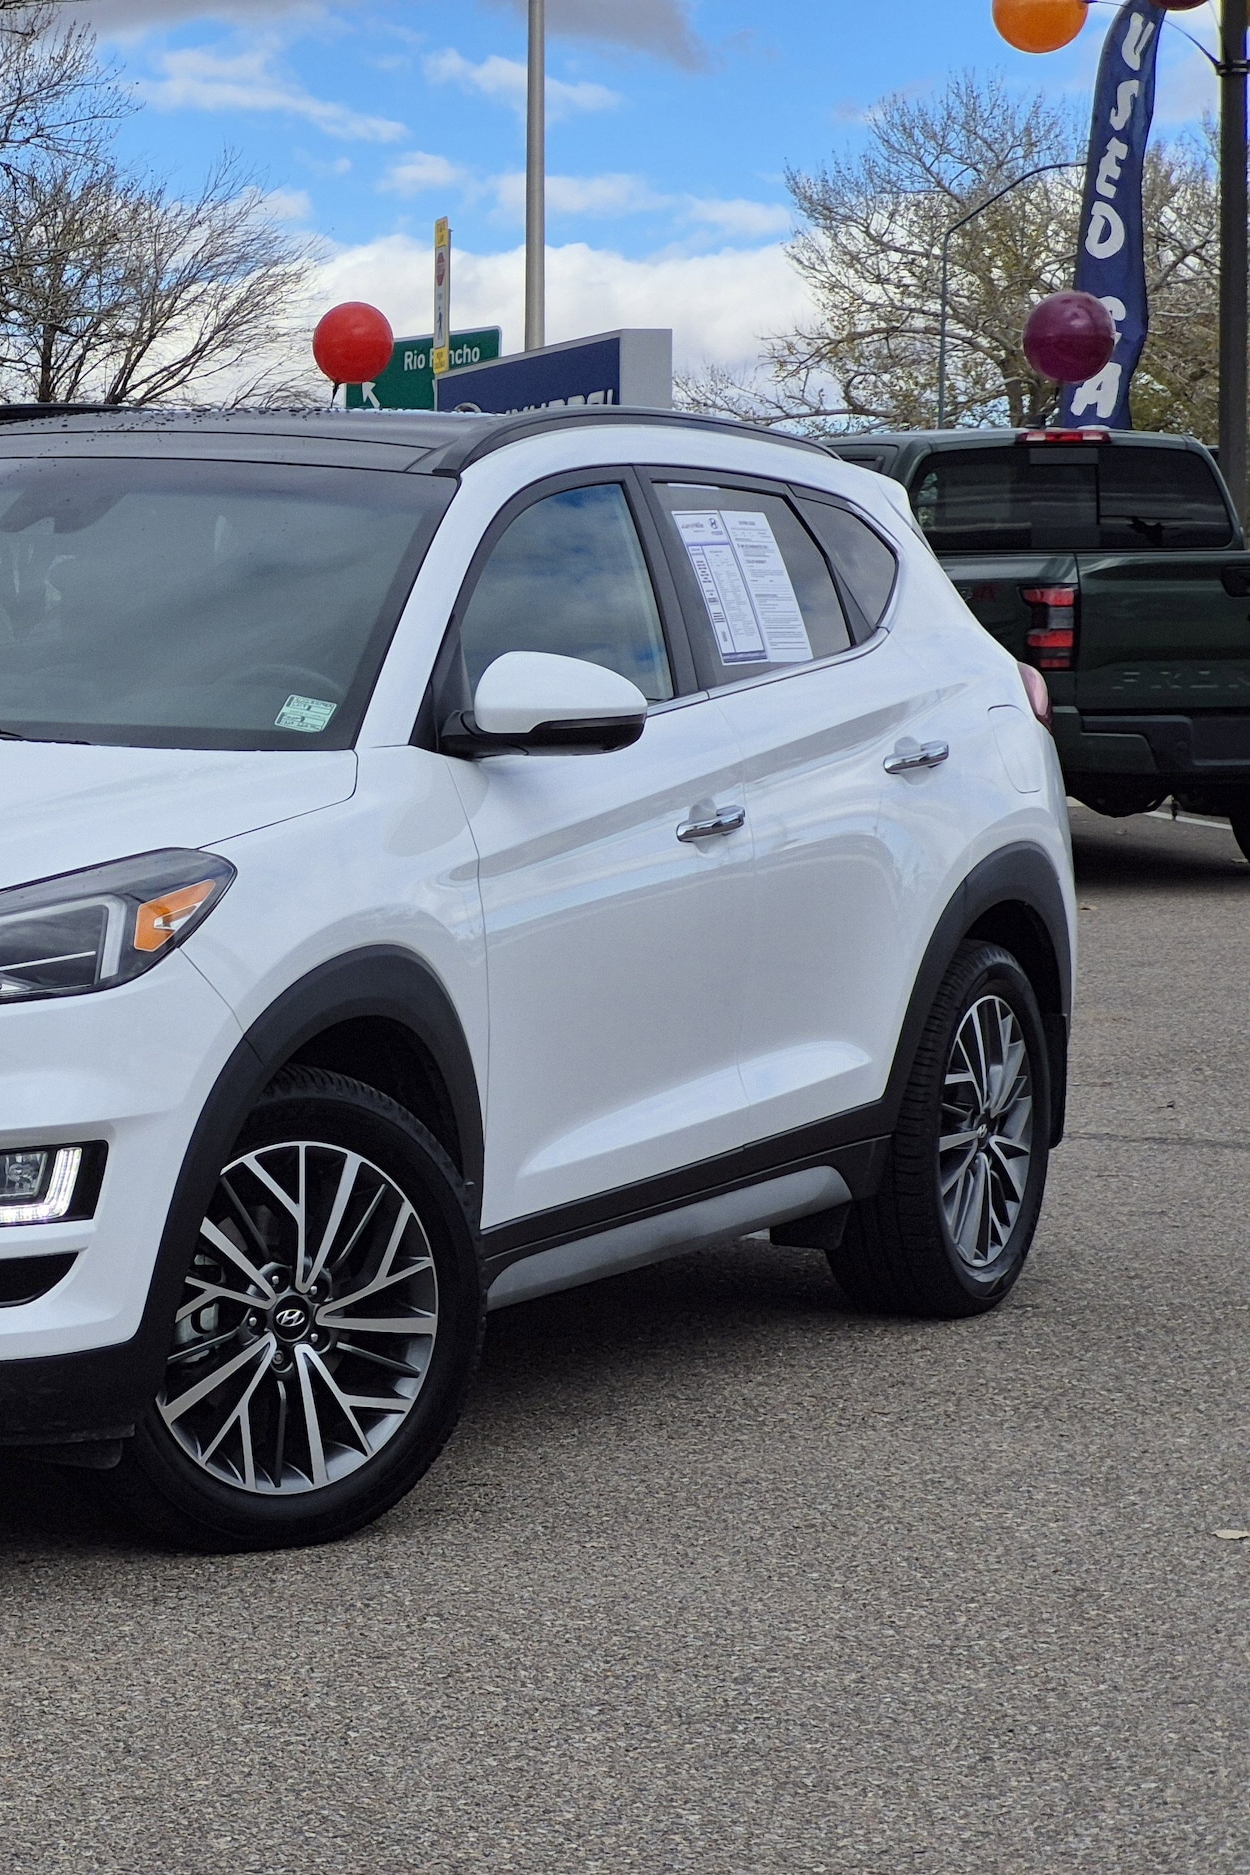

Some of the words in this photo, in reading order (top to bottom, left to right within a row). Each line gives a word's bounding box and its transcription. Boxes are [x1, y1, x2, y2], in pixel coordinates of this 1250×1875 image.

[1084, 11, 1155, 260] USED
[403, 349, 426, 371] Rio
[429, 343, 481, 368] ncho
